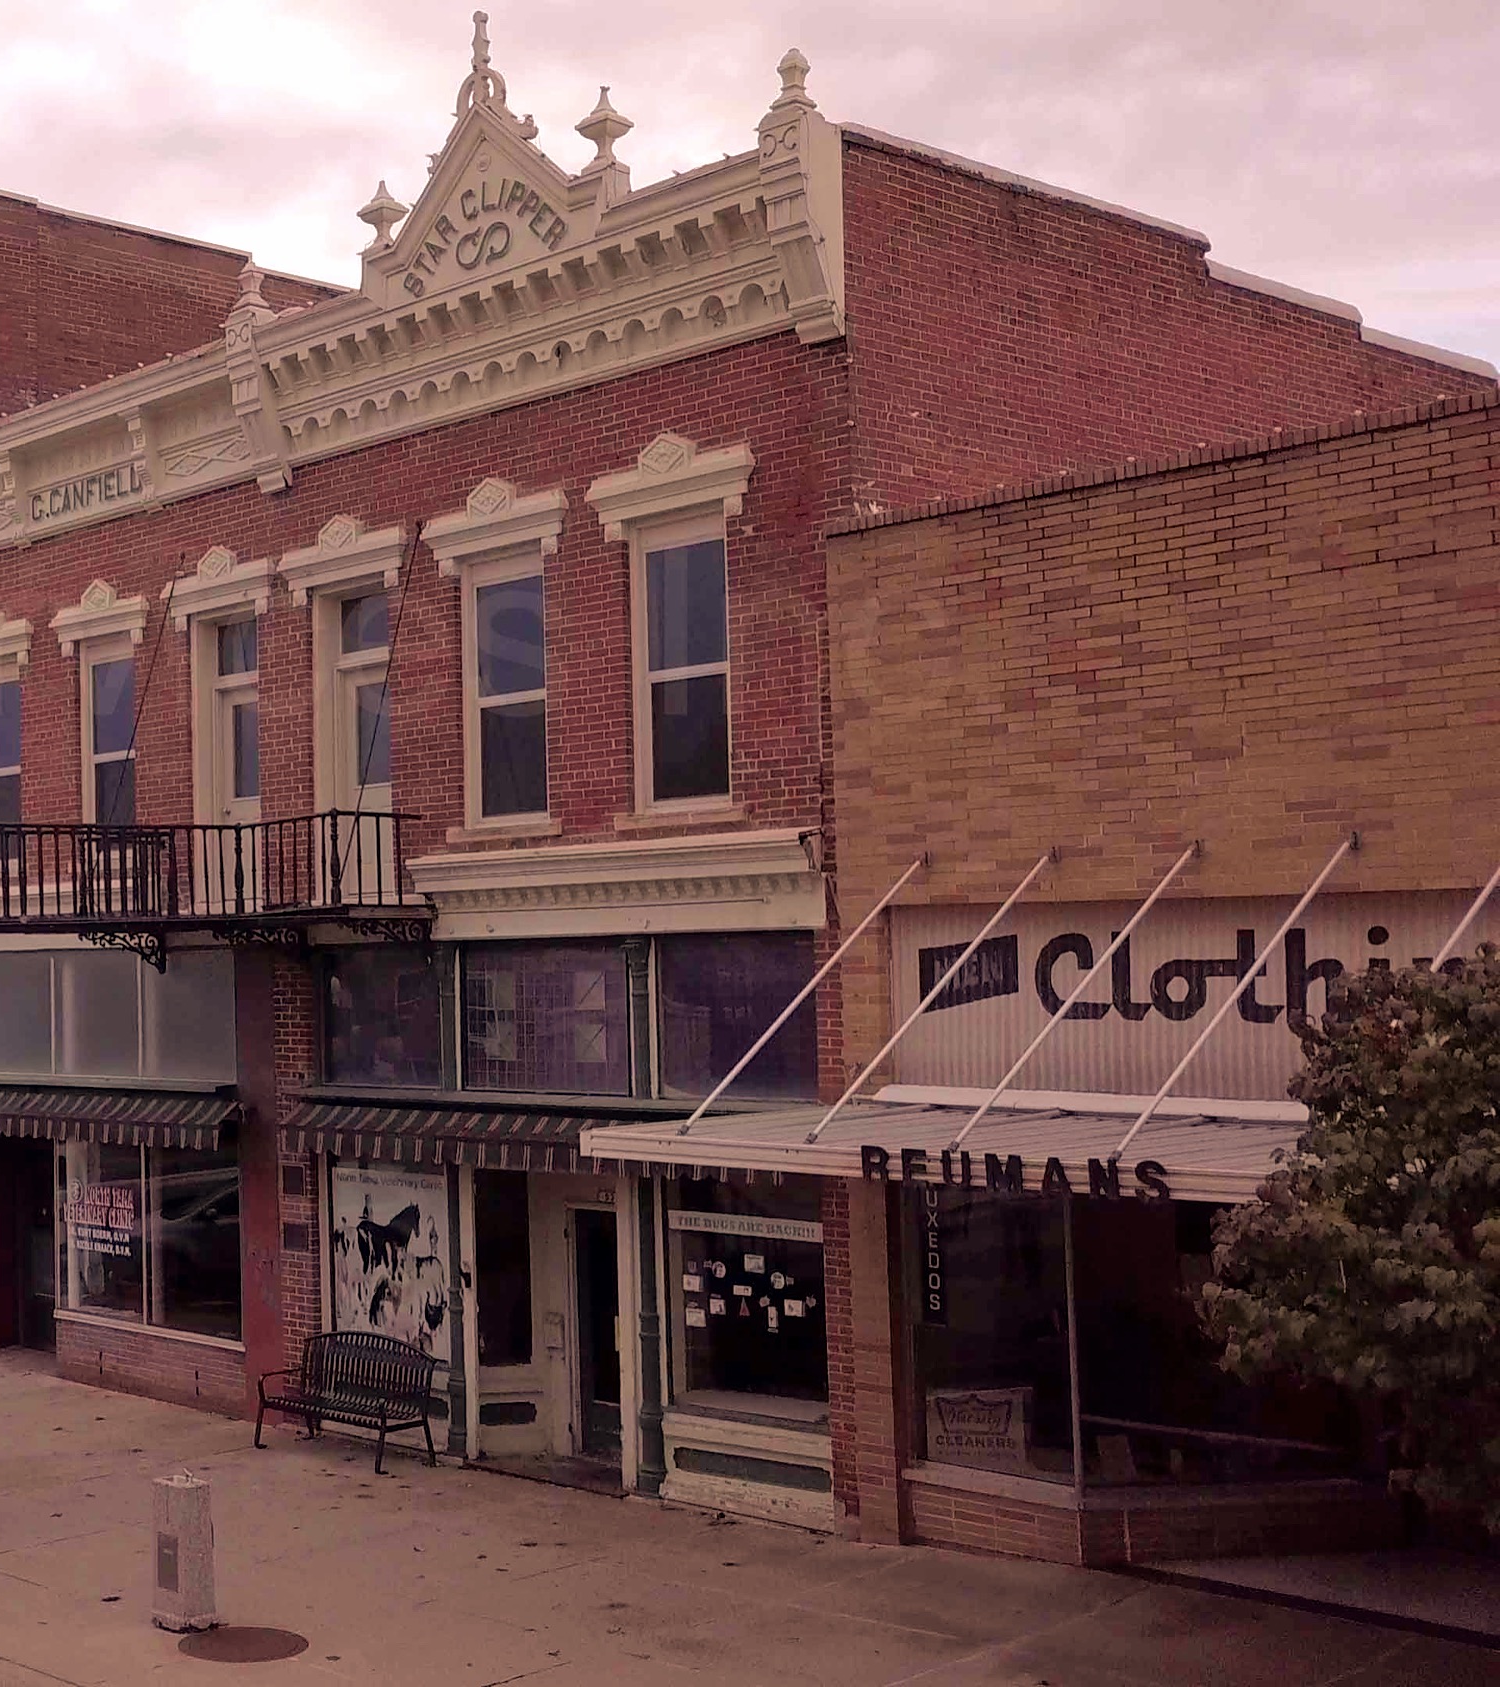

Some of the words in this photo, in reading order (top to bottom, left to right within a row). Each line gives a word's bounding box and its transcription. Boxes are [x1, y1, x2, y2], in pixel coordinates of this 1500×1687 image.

[404, 215, 458, 298] STAR
[460, 179, 567, 250] CLIPPER
[108, 1207, 135, 1230] CLINIC
[677, 1216, 701, 1227] THE
[925, 1188, 941, 1311] UXEDOS
